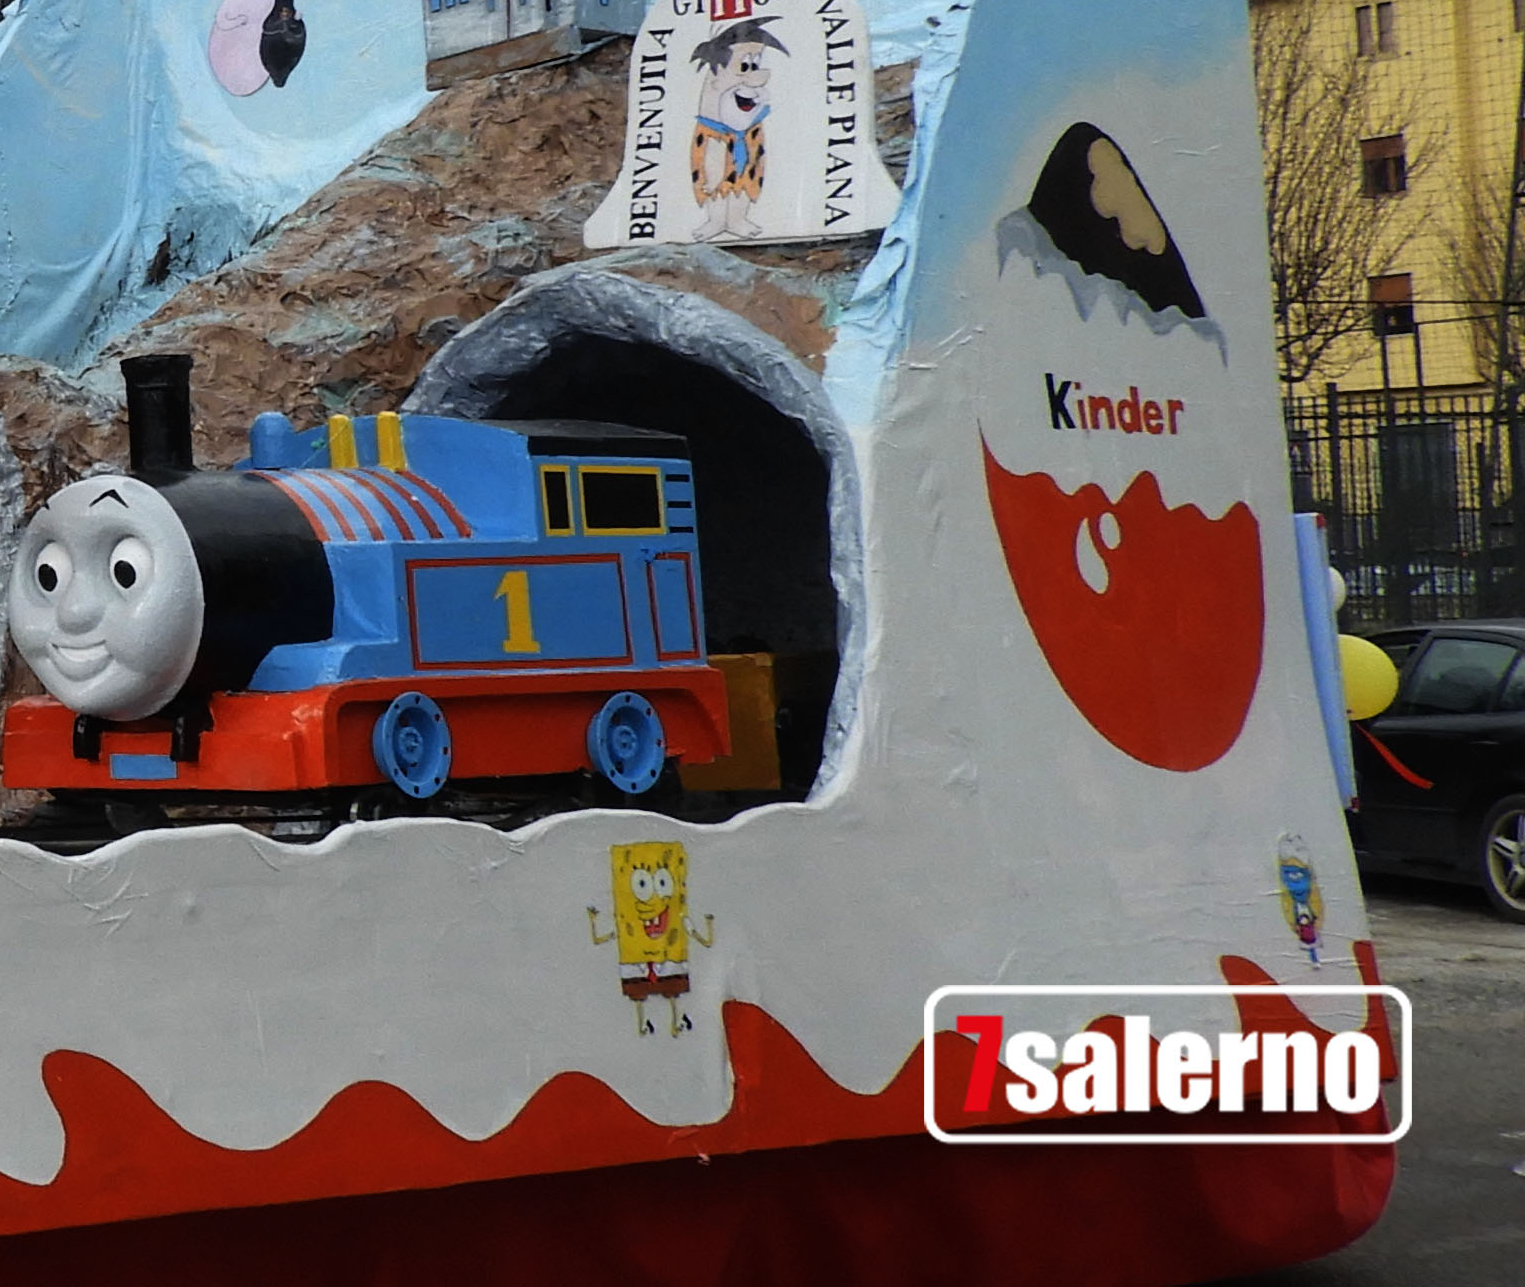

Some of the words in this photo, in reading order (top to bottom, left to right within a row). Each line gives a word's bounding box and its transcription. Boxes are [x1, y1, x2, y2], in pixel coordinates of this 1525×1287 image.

[824, 114, 855, 227] PIANA
[1044, 372, 1185, 436] Kinder
[493, 570, 541, 654] 1
